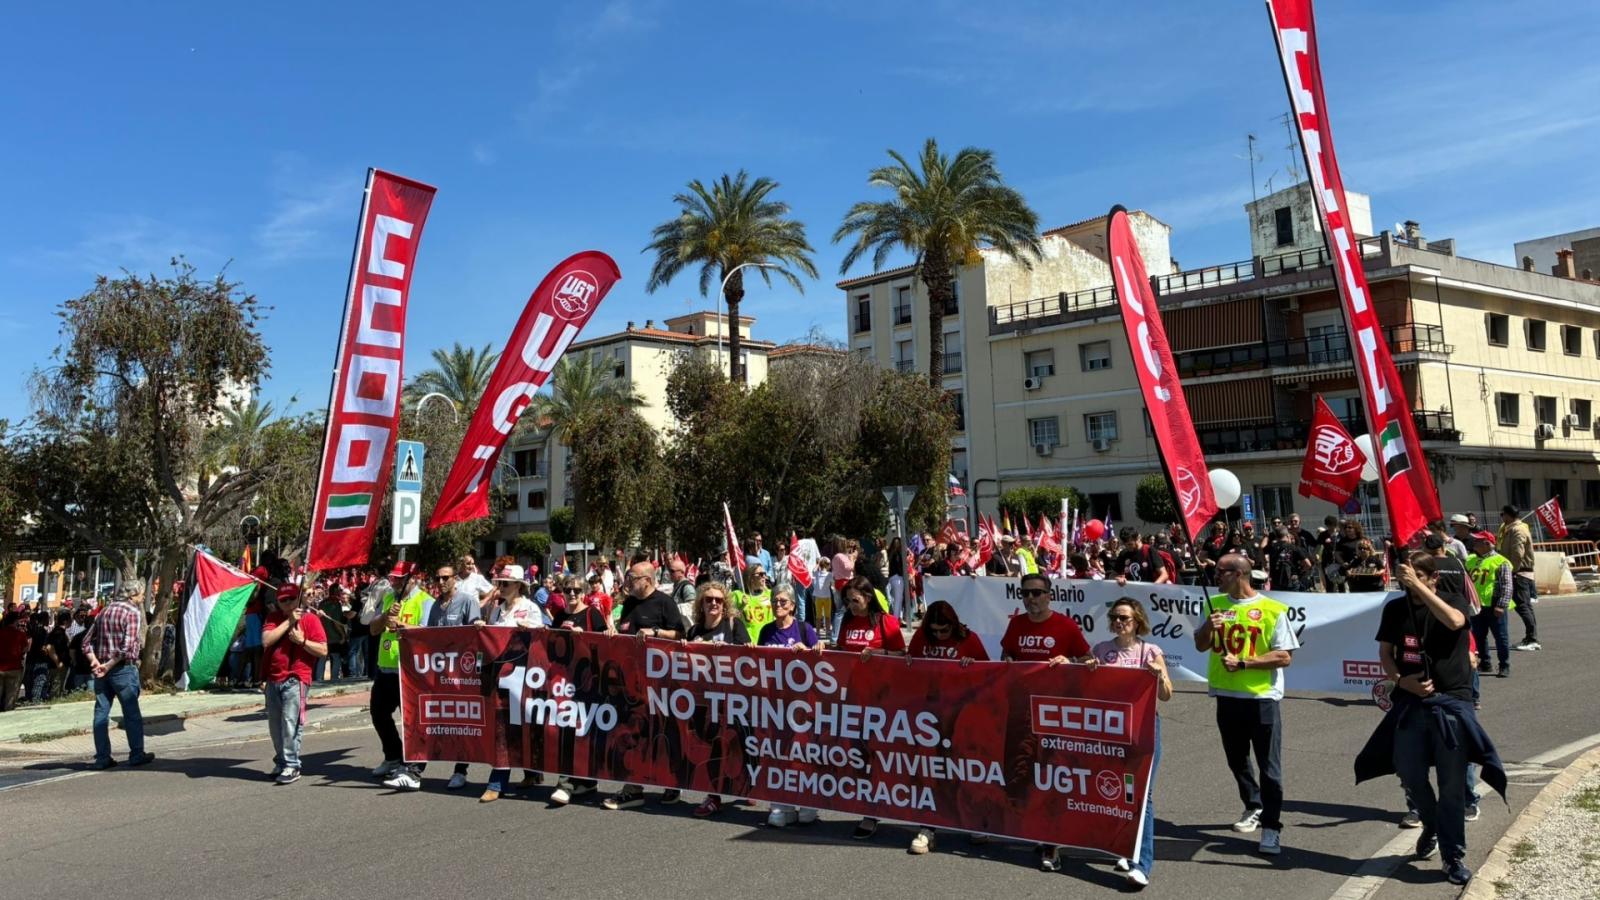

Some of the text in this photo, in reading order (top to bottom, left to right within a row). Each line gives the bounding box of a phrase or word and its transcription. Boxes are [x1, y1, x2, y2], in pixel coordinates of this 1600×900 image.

[559, 275, 596, 305] UGT
[331, 213, 414, 484] CCOO
[399, 497, 416, 540] P
[1049, 586, 1085, 603] alario
[846, 629, 865, 640] UGT
[1152, 615, 1184, 640] de
[1018, 635, 1042, 647] UGT
[413, 651, 458, 674] UGT
[646, 647, 847, 701] DERECHOS,
[440, 676, 482, 687] Extremadura
[552, 677, 576, 698] de
[425, 701, 481, 720] CCOO
[525, 697, 618, 737] mayo
[647, 686, 952, 749] NO TRINCHERAS.
[1038, 703, 1125, 736] CCOO
[425, 725, 482, 737] extremadura
[1040, 736, 1126, 758] extremadura
[745, 735, 1006, 787] SALARIOS, VIVIENDA
[746, 764, 937, 812] Y DEMOCRACIA
[1034, 762, 1092, 796] UGT
[1066, 798, 1134, 820] Extremadura
